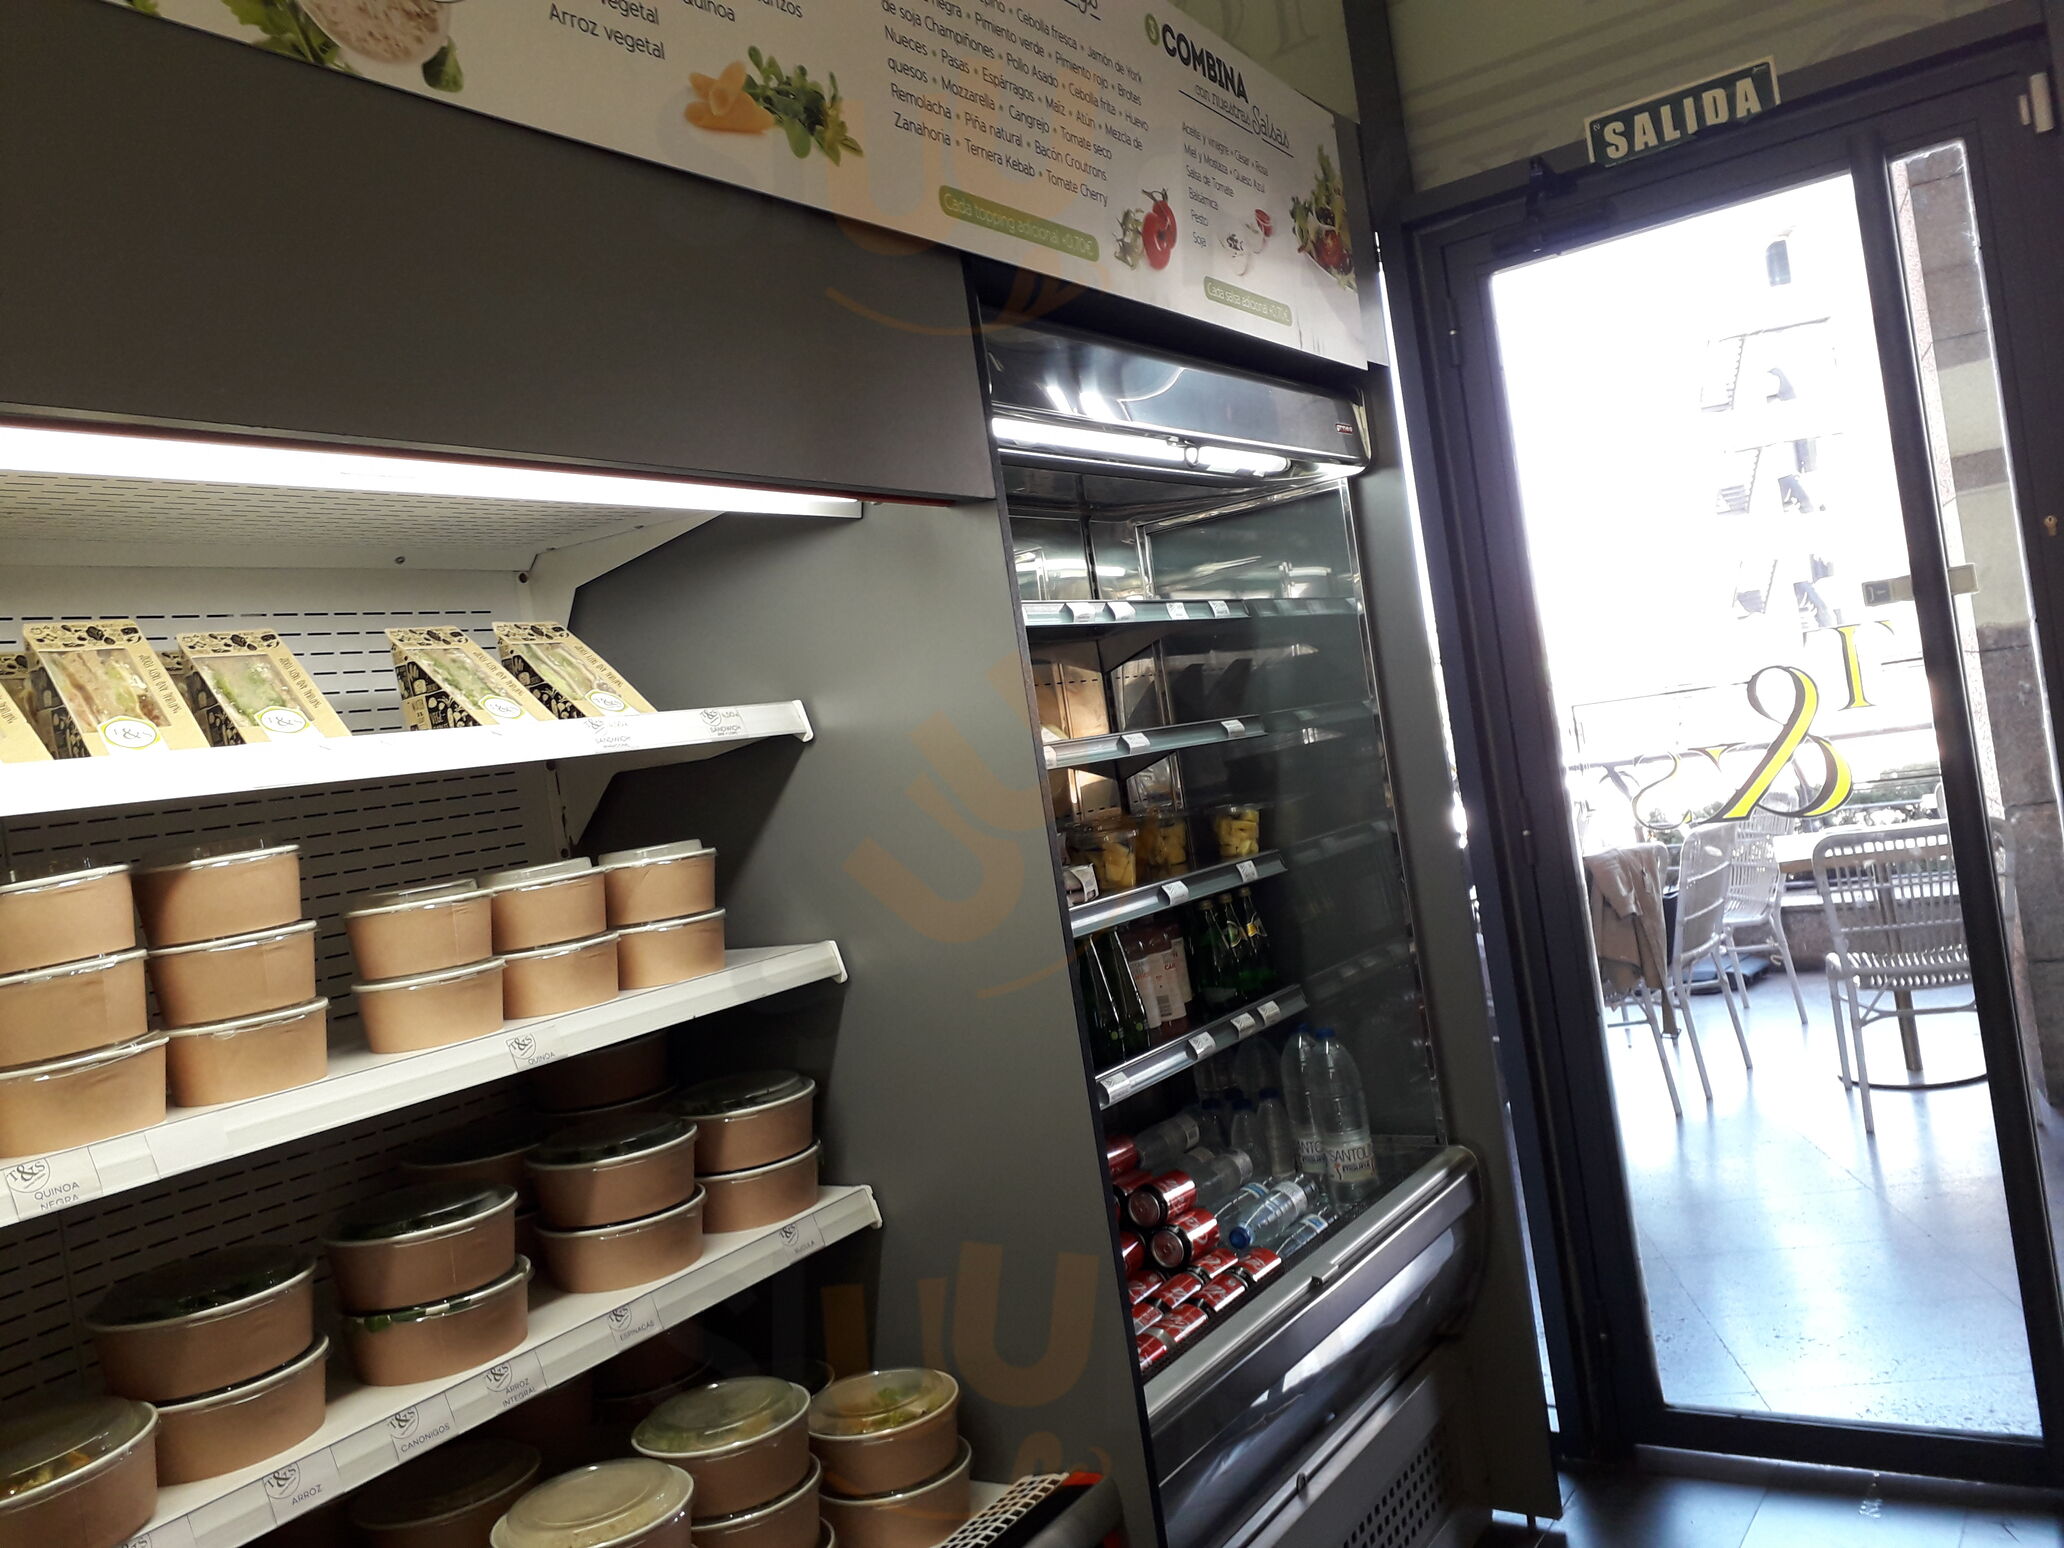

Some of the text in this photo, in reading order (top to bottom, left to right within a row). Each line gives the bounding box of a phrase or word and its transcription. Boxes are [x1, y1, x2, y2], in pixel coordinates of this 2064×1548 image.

[601, 0, 660, 26] egetal
[549, 4, 666, 60] Arroz vegetal
[1017, 8, 1051, 35] Cebolla
[1051, 25, 1079, 50] fresca
[900, 7, 922, 27] soja
[924, 16, 995, 60] Champiñones
[1006, 52, 1029, 75] Pollo
[1031, 65, 1059, 89] Asado
[1068, 82, 1099, 108] Cebolla
[1099, 96, 1117, 116] frita
[1125, 111, 1149, 133] Huevo
[975, 12, 1017, 44] Pimiento
[1019, 36, 1045, 58] verde
[1055, 51, 1092, 81] Pimiento
[1117, 83, 1142, 107] Brotes
[1162, 23, 1249, 104] COMBINA
[884, 25, 1143, 152] Nueces Pasas Espárragos Maíz Atún Mezcla de
[887, 57, 1112, 160] quesos Mozzarella Cangrejo Tomate seco
[1603, 77, 1762, 159] SALIDA
[890, 82, 951, 119] Remolacha
[964, 111, 987, 134] Piña
[989, 123, 1023, 147] natural
[1035, 139, 1064, 165] Bacón
[894, 111, 1108, 208] Zanahoria Ternera Kebab Tomate Cherry
[509, 1035, 533, 1052] T&S
[528, 1051, 556, 1065] QUINOA
[6, 1160, 46, 1184] T&S
[34, 1181, 80, 1201] QUINOA
[485, 1365, 509, 1382] T&S
[505, 1378, 530, 1394] ARROZ
[502, 1386, 536, 1408] INTEGRAL
[387, 1410, 416, 1429] T&S
[400, 1422, 451, 1453] CANONIGOS
[265, 1467, 297, 1488] T&S
[292, 1483, 322, 1506] ARROZ
